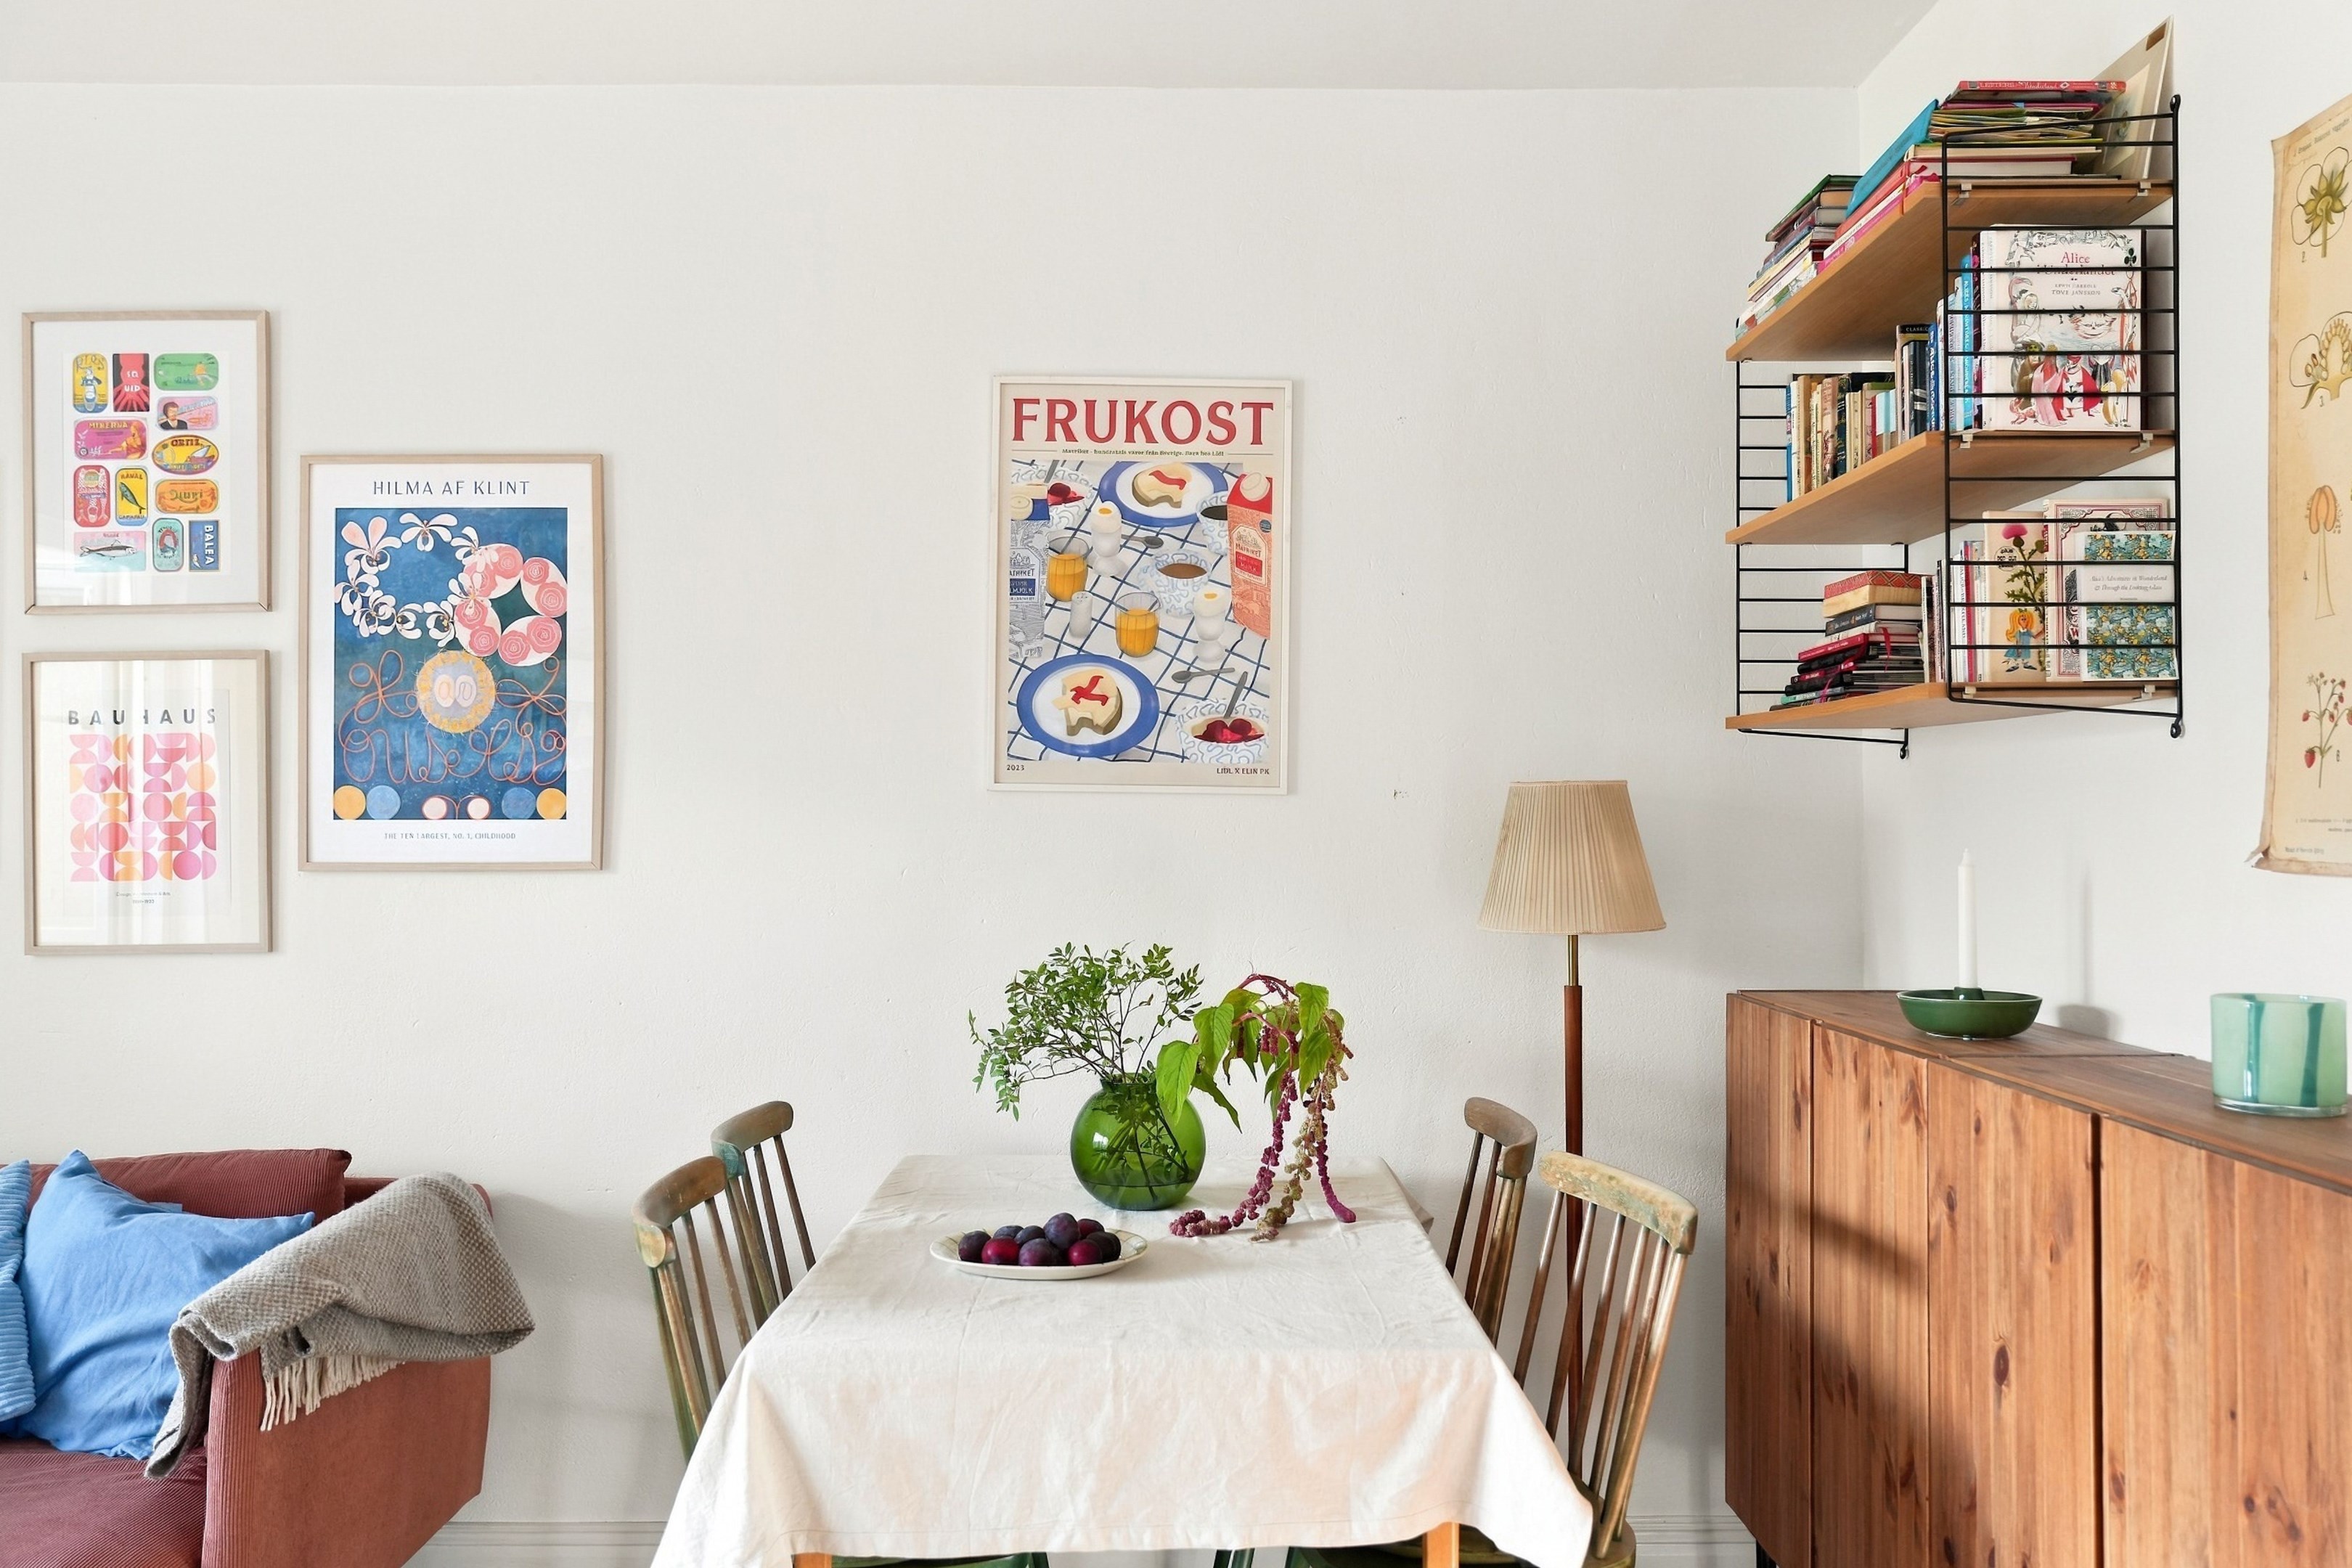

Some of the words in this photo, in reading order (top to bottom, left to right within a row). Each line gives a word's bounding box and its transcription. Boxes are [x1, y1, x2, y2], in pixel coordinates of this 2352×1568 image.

[2060, 251, 2091, 264] Alice
[1013, 398, 1274, 446] FRUKOST
[373, 481, 433, 495] HILMA
[441, 481, 465, 495] AF
[474, 481, 530, 495] KLINT
[204, 525, 216, 566] BALEA
[1236, 542, 1262, 558] MATRIKET
[68, 708, 217, 725] BAUHAUS
